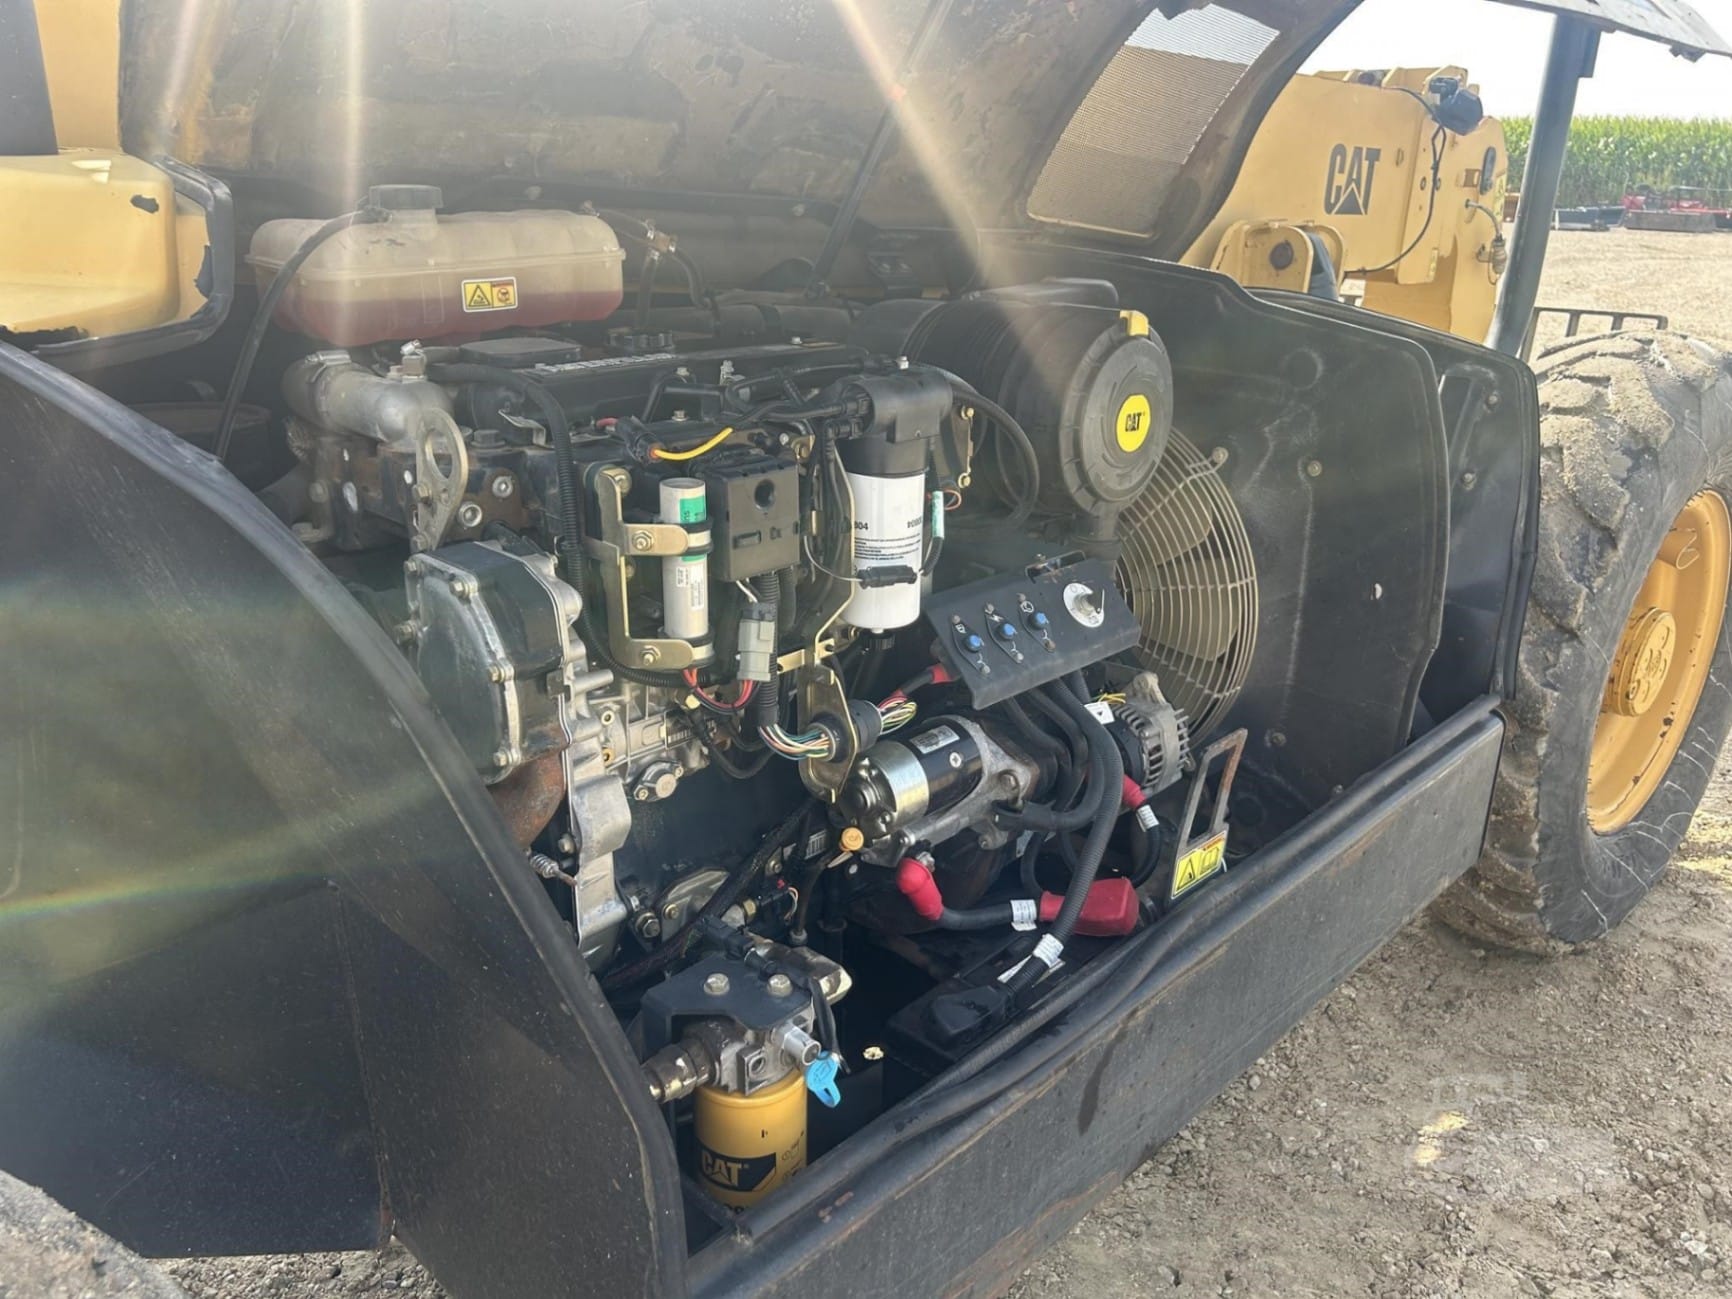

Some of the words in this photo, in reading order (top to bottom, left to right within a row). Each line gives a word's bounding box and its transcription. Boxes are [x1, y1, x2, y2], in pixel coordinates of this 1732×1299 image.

[1324, 143, 1382, 216] CAT
[1125, 412, 1142, 432] CAT
[702, 1150, 742, 1187] CAT
